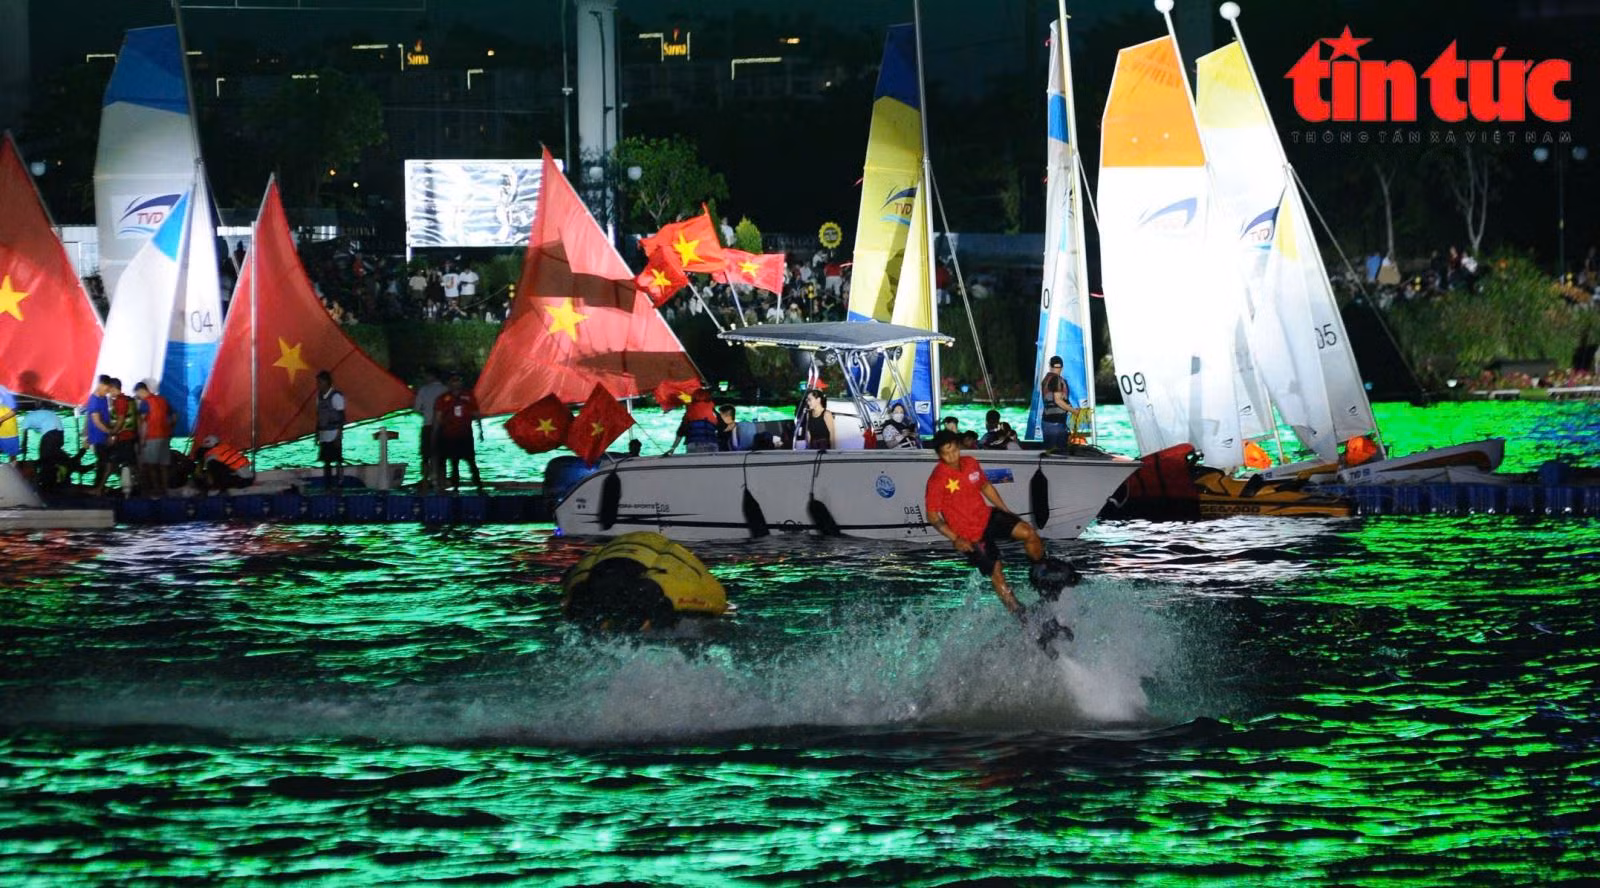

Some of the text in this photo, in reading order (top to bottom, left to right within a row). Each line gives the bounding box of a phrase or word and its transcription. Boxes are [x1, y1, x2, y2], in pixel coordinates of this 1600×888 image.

[895, 202, 913, 216] TVD
[136, 211, 165, 226] TVD
[1250, 227, 1270, 242] TVD
[190, 310, 214, 333] 04
[1120, 371, 1147, 395] 09
